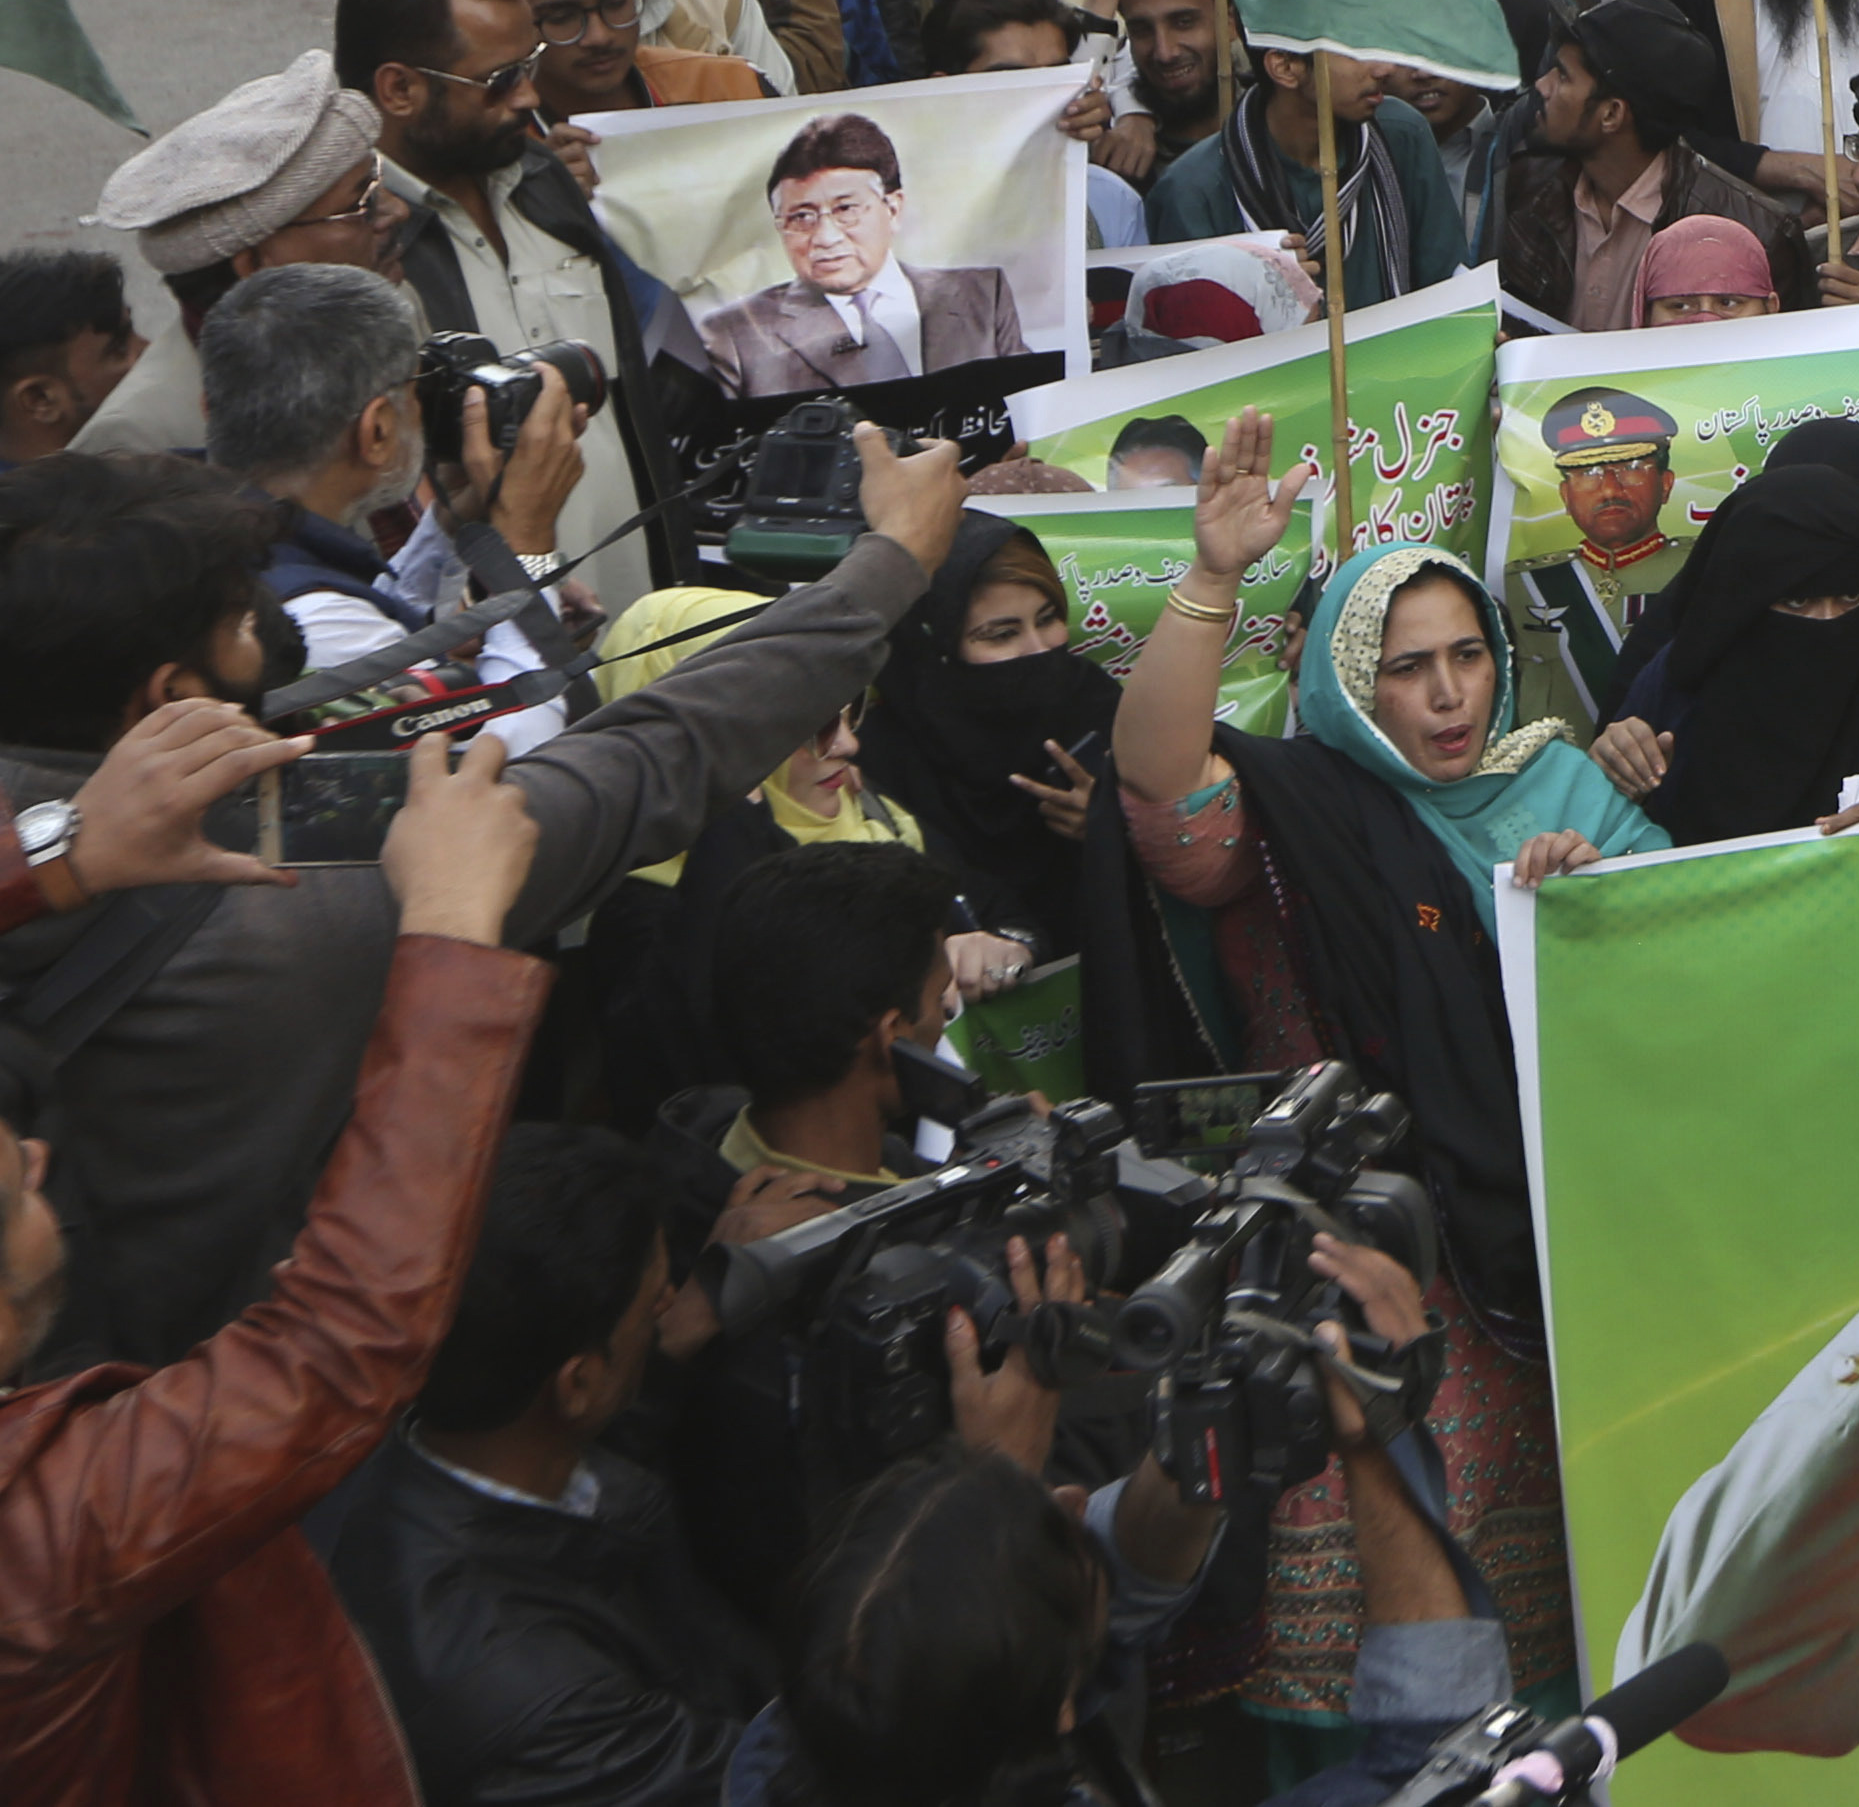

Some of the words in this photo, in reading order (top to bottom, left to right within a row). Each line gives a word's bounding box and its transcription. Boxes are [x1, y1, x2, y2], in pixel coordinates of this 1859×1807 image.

[1374, 402, 1464, 483] جنرل
[1695, 394, 1770, 444] پاکستان
[391, 697, 494, 738] Canon
